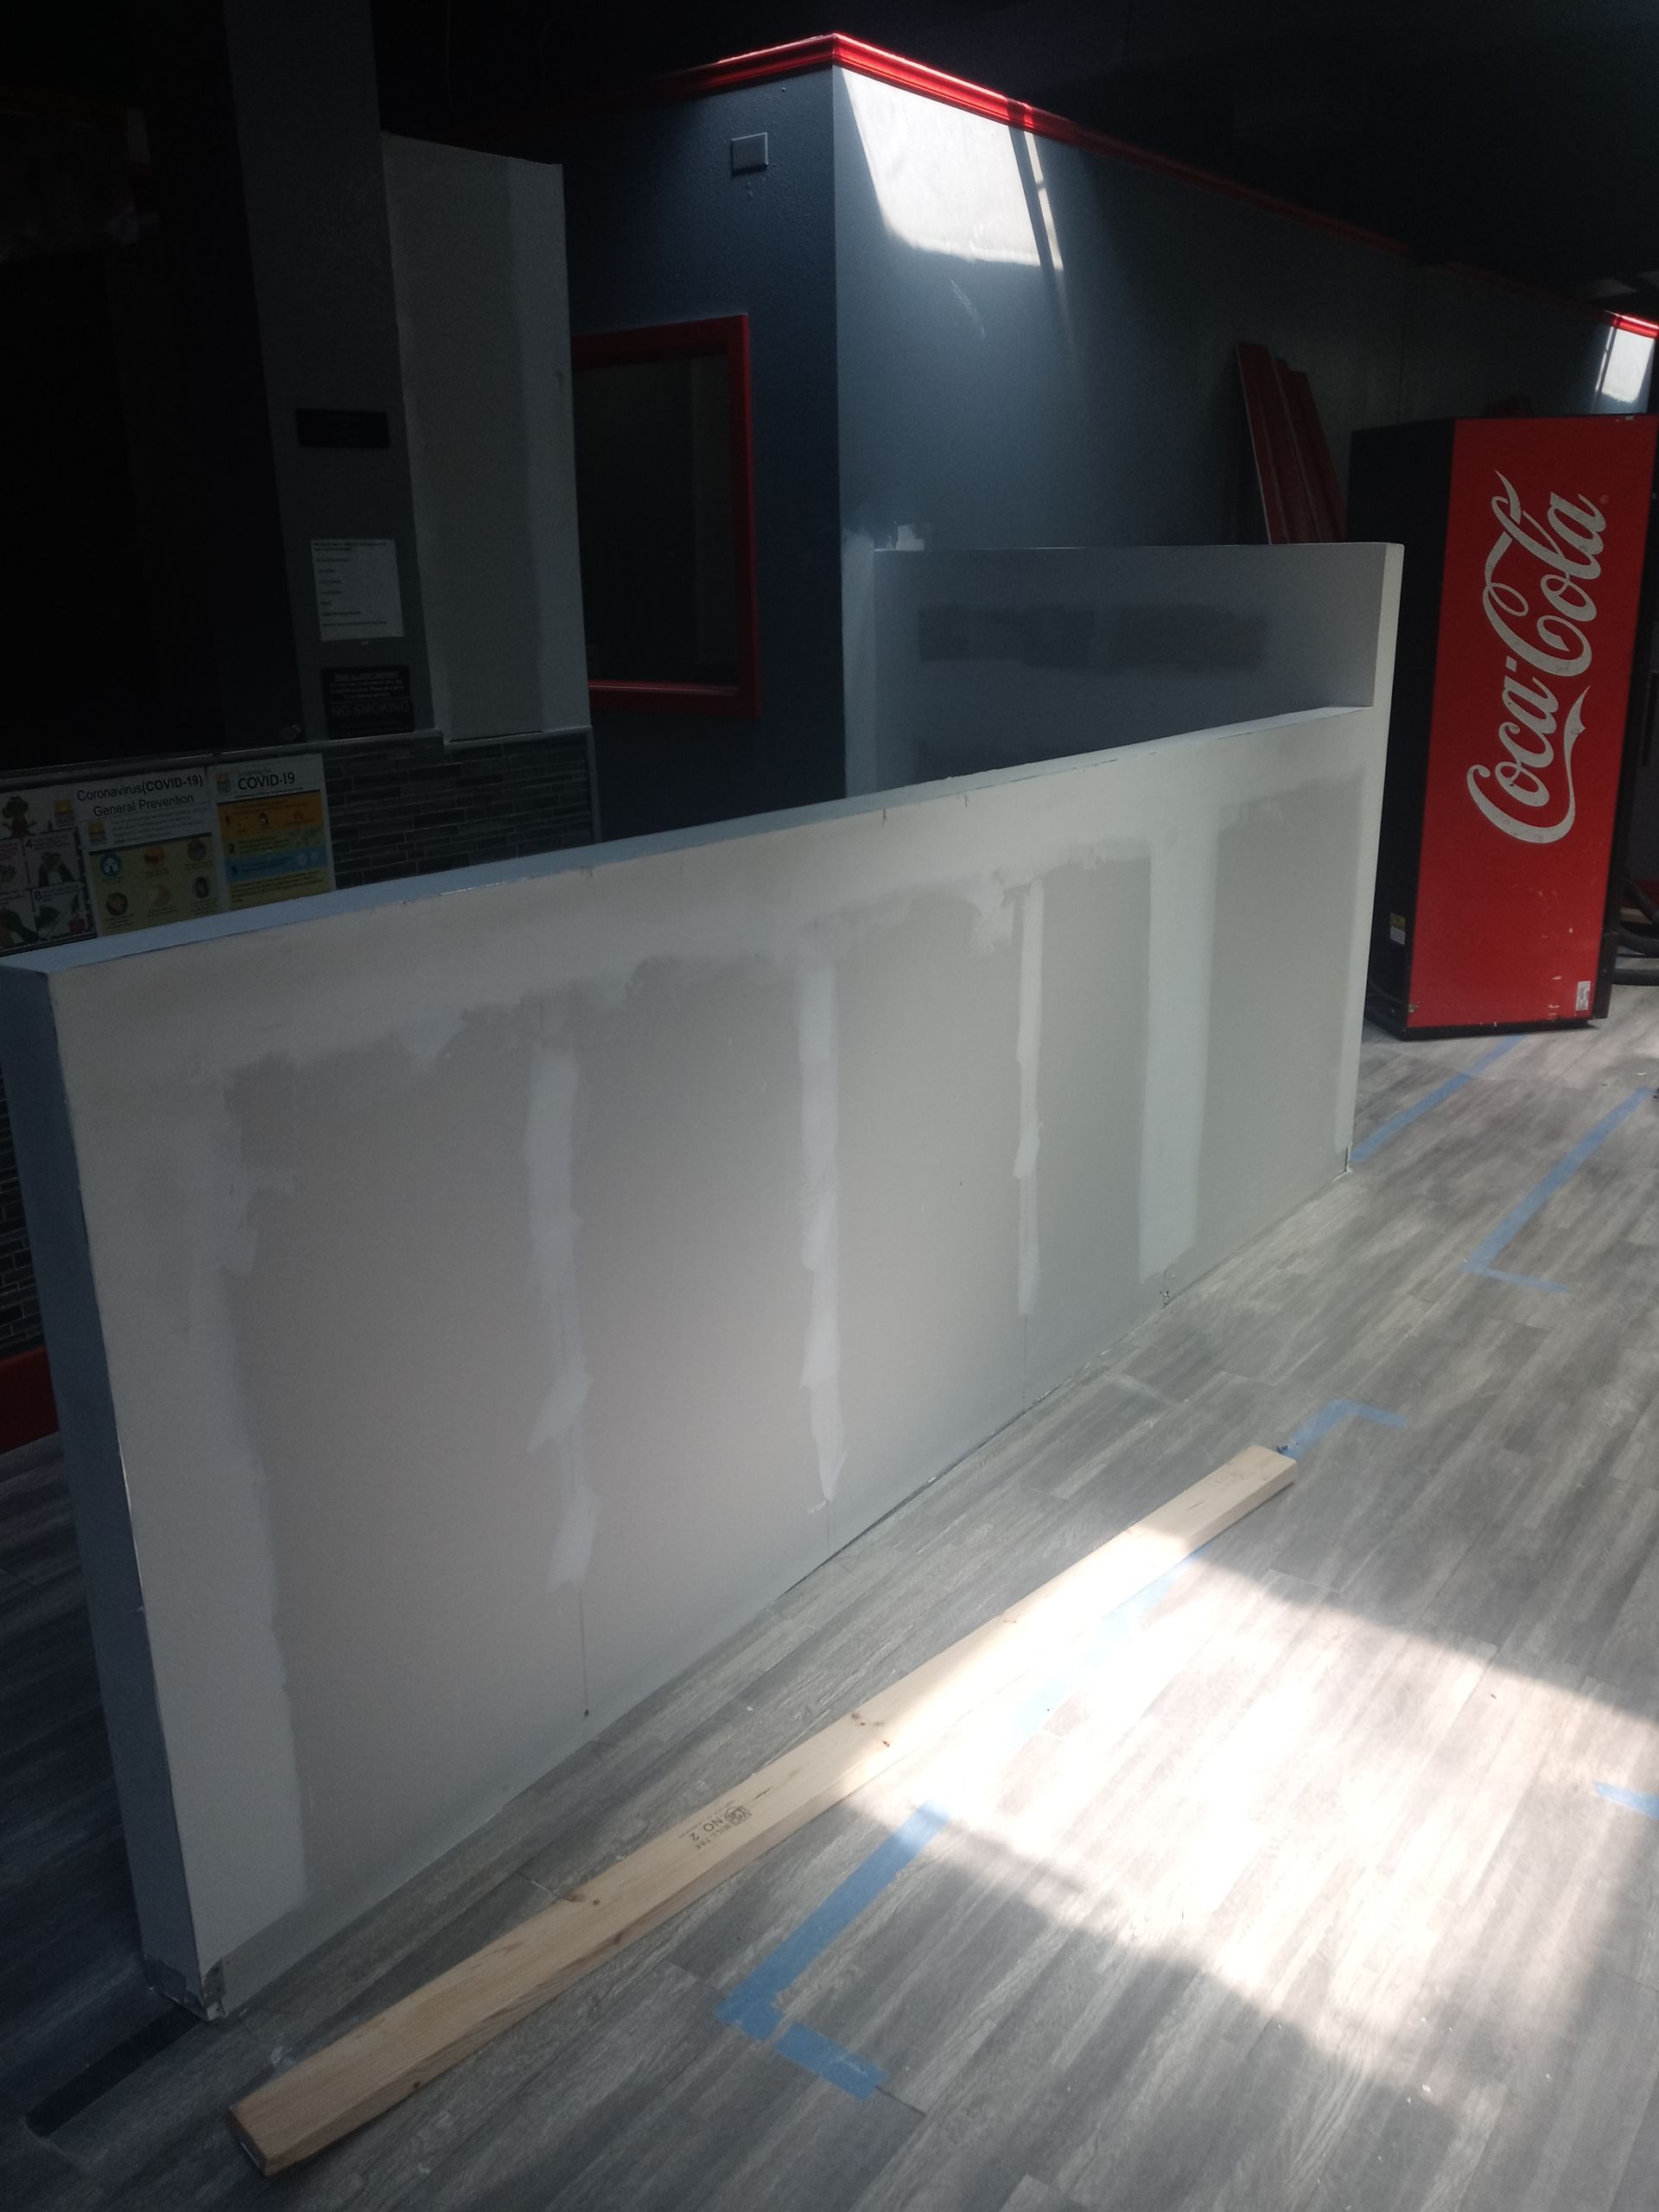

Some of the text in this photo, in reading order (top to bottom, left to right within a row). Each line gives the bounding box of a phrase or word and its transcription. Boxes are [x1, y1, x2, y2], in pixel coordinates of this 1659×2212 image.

[1466, 469, 1607, 844] Coca-Cola
[332, 700, 410, 719] NO SMOKING
[76, 774, 204, 802] Coronavirus(COVID-19)
[238, 771, 296, 790] COVID-19
[93, 794, 194, 817] General Prevention
[25, 838, 33, 849] 4
[34, 890, 42, 900] 8
[689, 1816, 723, 1841] NO 2
